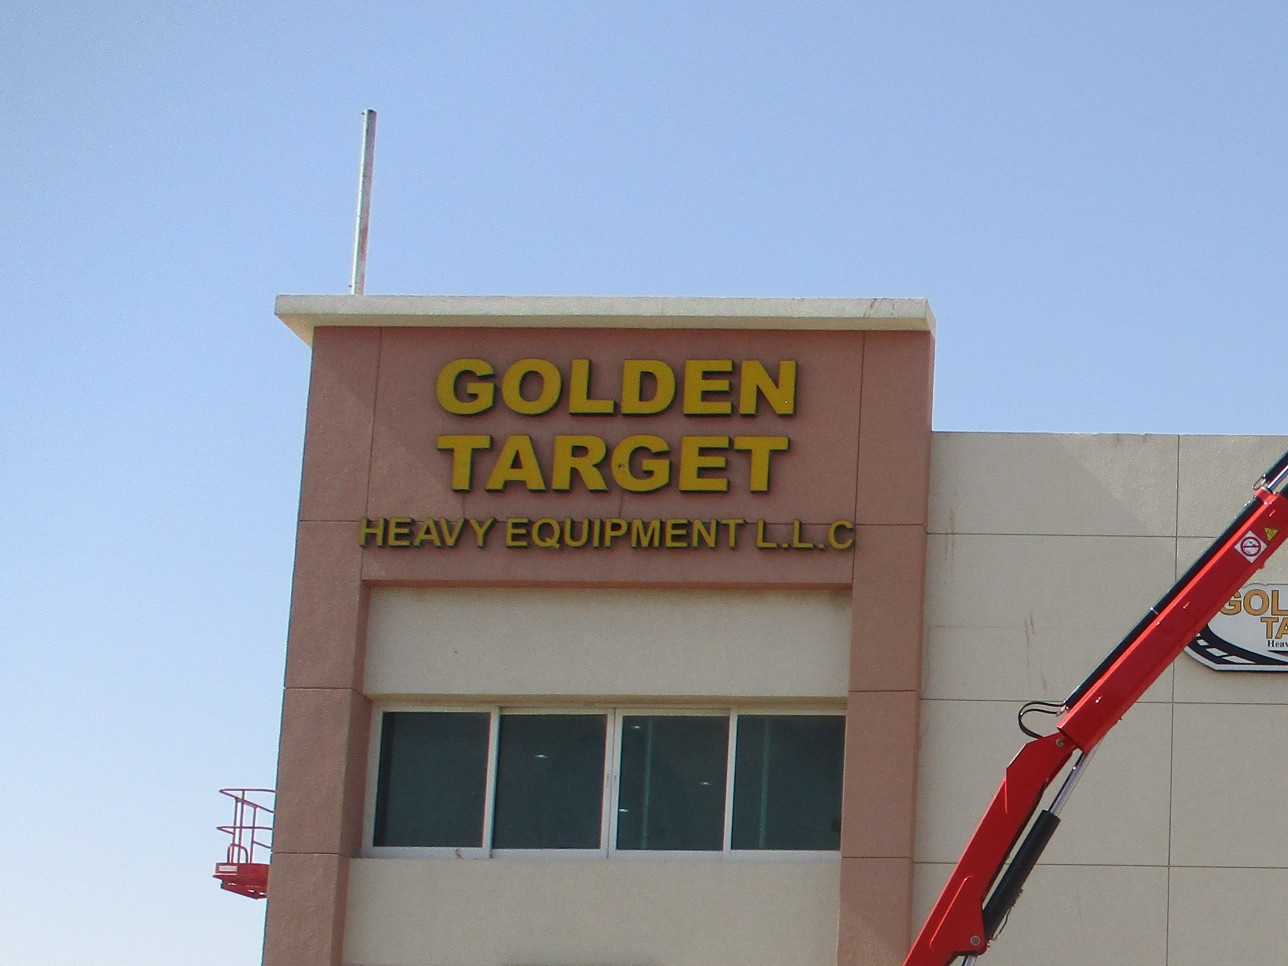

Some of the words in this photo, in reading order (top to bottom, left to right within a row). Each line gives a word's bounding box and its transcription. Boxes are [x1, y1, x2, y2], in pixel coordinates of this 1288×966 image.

[435, 358, 797, 416] GOLDEN
[436, 435, 789, 493] TARGET
[358, 517, 496, 549] HEAVY
[505, 518, 745, 551] EQUIPMENT
[756, 519, 857, 551] L.L.C
